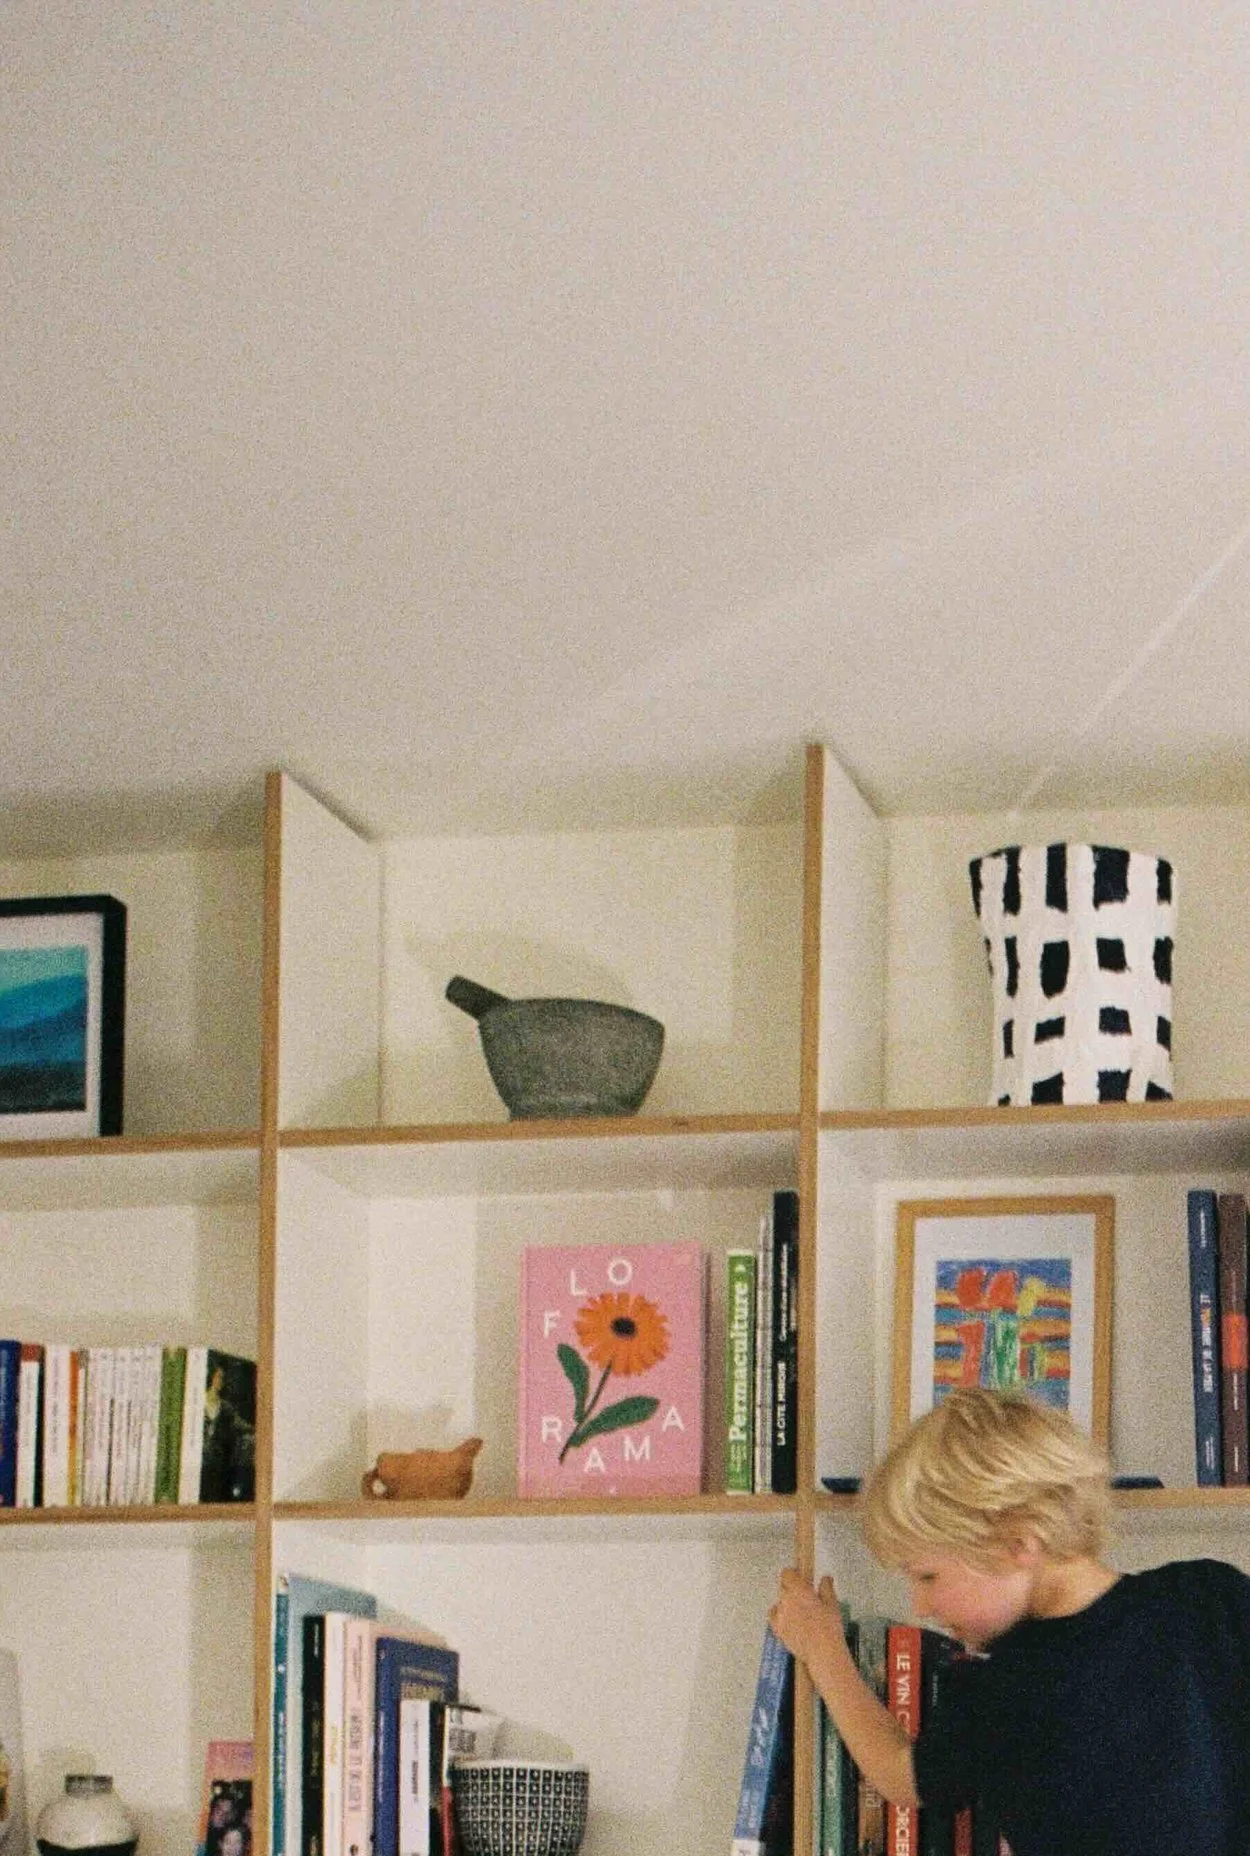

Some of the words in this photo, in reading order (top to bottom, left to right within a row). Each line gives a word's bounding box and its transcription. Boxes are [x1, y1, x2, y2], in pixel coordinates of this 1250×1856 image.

[728, 1281, 750, 1442] Permaculture
[896, 1654, 911, 1670] LE
[896, 1674, 911, 1706] VIN
